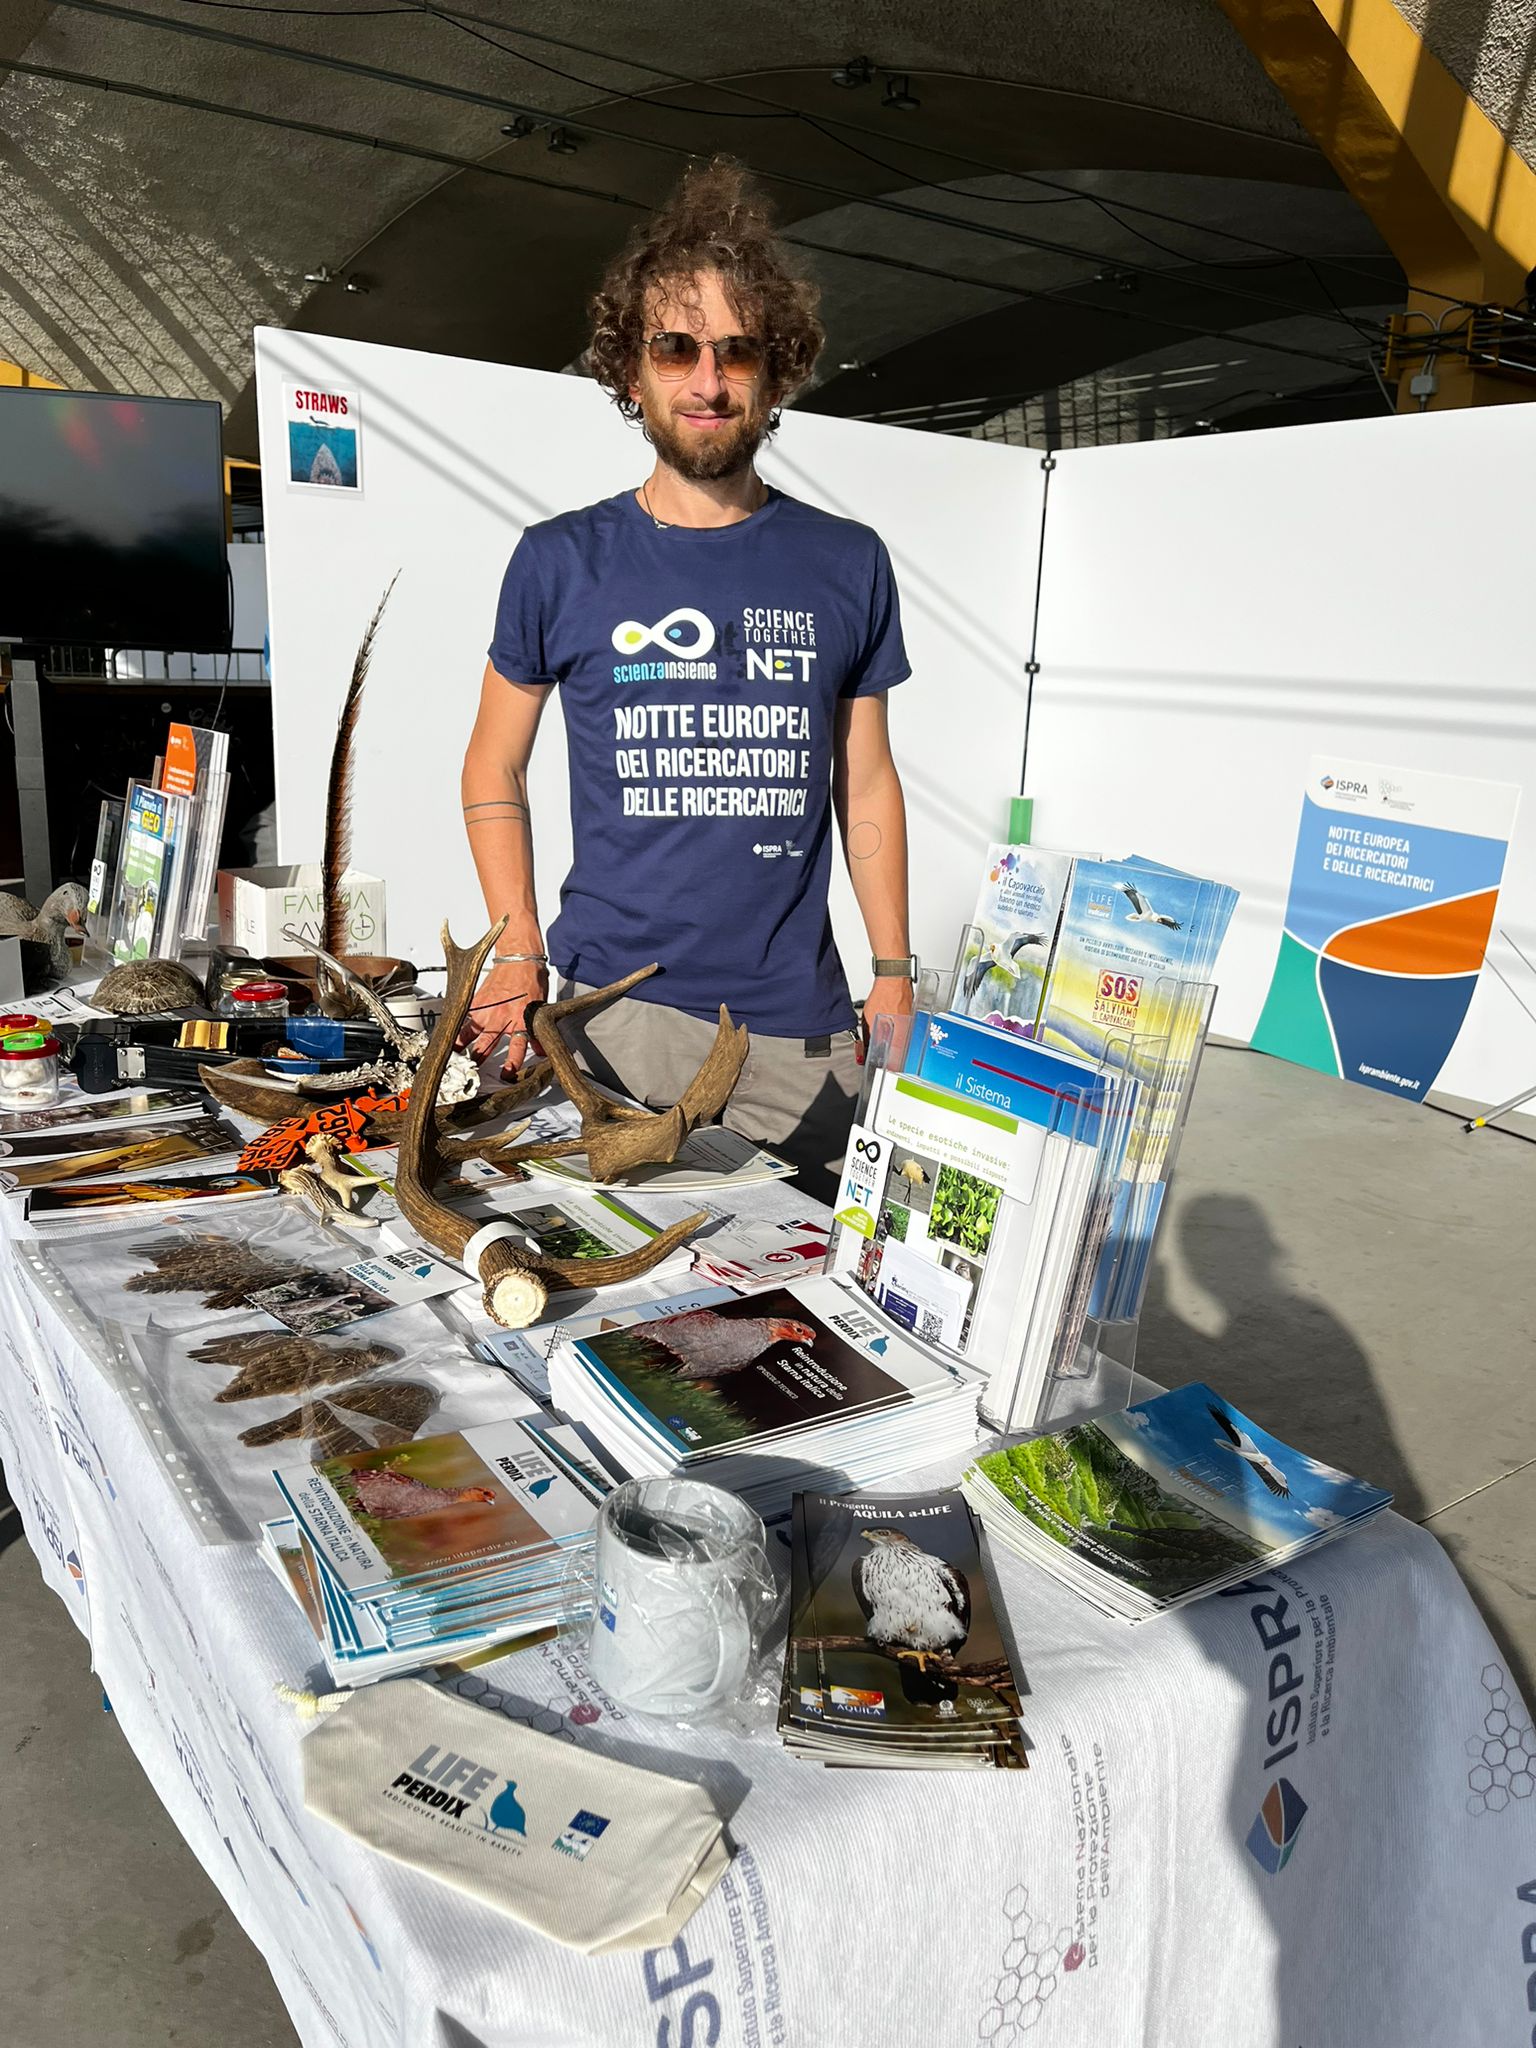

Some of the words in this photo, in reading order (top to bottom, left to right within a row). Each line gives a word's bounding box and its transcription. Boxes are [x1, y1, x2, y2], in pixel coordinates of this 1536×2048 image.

[295, 390, 348, 415] STRAWS
[743, 607, 814, 632] SCIENCE
[744, 628, 816, 646] TOGETHER
[613, 661, 717, 683] scienzainsieme
[746, 648, 817, 682] NET
[614, 704, 696, 740] NOTTE
[702, 704, 810, 740] EUROPEA
[616, 749, 649, 778] DEI
[655, 748, 795, 778] RICERCATORI
[800, 750, 809, 778] E
[623, 787, 678, 816] DELLE
[682, 786, 807, 816] RICERCATRICI
[1336, 779, 1368, 794] ISPRA
[1328, 825, 1362, 844] NOTTE
[1363, 832, 1410, 854] EUROPEA
[1326, 841, 1342, 856] DEI
[1344, 845, 1409, 870] RICERCATORI
[1323, 857, 1331, 871] E
[1331, 859, 1363, 878] DELLE
[1364, 866, 1435, 893] RICERCATRICI
[1090, 892, 1114, 906] LIFE
[1101, 975, 1139, 1001] SOS
[1094, 999, 1138, 1019] SALVIAMO
[955, 1072, 963, 1089] il
[965, 1076, 1011, 1109] Sistema
[888, 1114, 896, 1123] Le
[899, 1120, 925, 1137] specie
[928, 1132, 968, 1153] esotiche
[850, 1156, 878, 1180] SCIENCE
[846, 1179, 873, 1207] NET
[828, 1314, 863, 1340] PERDIX
[840, 1309, 882, 1337] LIFE
[776, 1359, 803, 1381] Starna
[800, 1378, 826, 1399] italica
[791, 1346, 848, 1391] Reintroduzione
[801, 1368, 829, 1389] natura
[495, 1456, 526, 1483] PERDIX
[511, 1449, 553, 1478] LIFE
[829, 1500, 876, 1511] Progetto
[853, 1509, 905, 1520] AQUILA
[908, 1505, 952, 1518] a-LIFE
[306, 1476, 352, 1538] REINTRODUZIONE
[347, 1540, 375, 1571] NATURA
[308, 1507, 333, 1537] STARNA
[325, 1535, 350, 1563] ITALICA
[1051, 1510, 1098, 1546] conservazione
[1096, 1543, 1111, 1553] del
[1267, 1569, 1309, 1599] Protezi
[1304, 1599, 1316, 1613] la
[1312, 1616, 1324, 1638] per
[1319, 1593, 1337, 1665] Ambientale
[587, 1680, 603, 1694] la
[1320, 1667, 1335, 1712] Ricerca
[598, 1696, 627, 1721] per
[837, 1703, 881, 1716] AQUILA
[1321, 1713, 1330, 1726] la
[1321, 1727, 1330, 1737] e
[408, 1744, 498, 1800] LIFE
[392, 1772, 471, 1819] PERDIX
[1061, 1734, 1086, 1861] Nazionale
[440, 1818, 474, 1838] BEAUTY
[476, 1834, 488, 1843] IN
[1084, 1771, 1100, 1901] Protezione
[739, 1842, 772, 1942] Ambientale
[1087, 1905, 1097, 1925] la
[729, 1905, 755, 1997] Superiore
[1088, 1933, 1098, 1968] per
[761, 1944, 782, 2014] Ricerca
[742, 1996, 762, 2048] stituto
